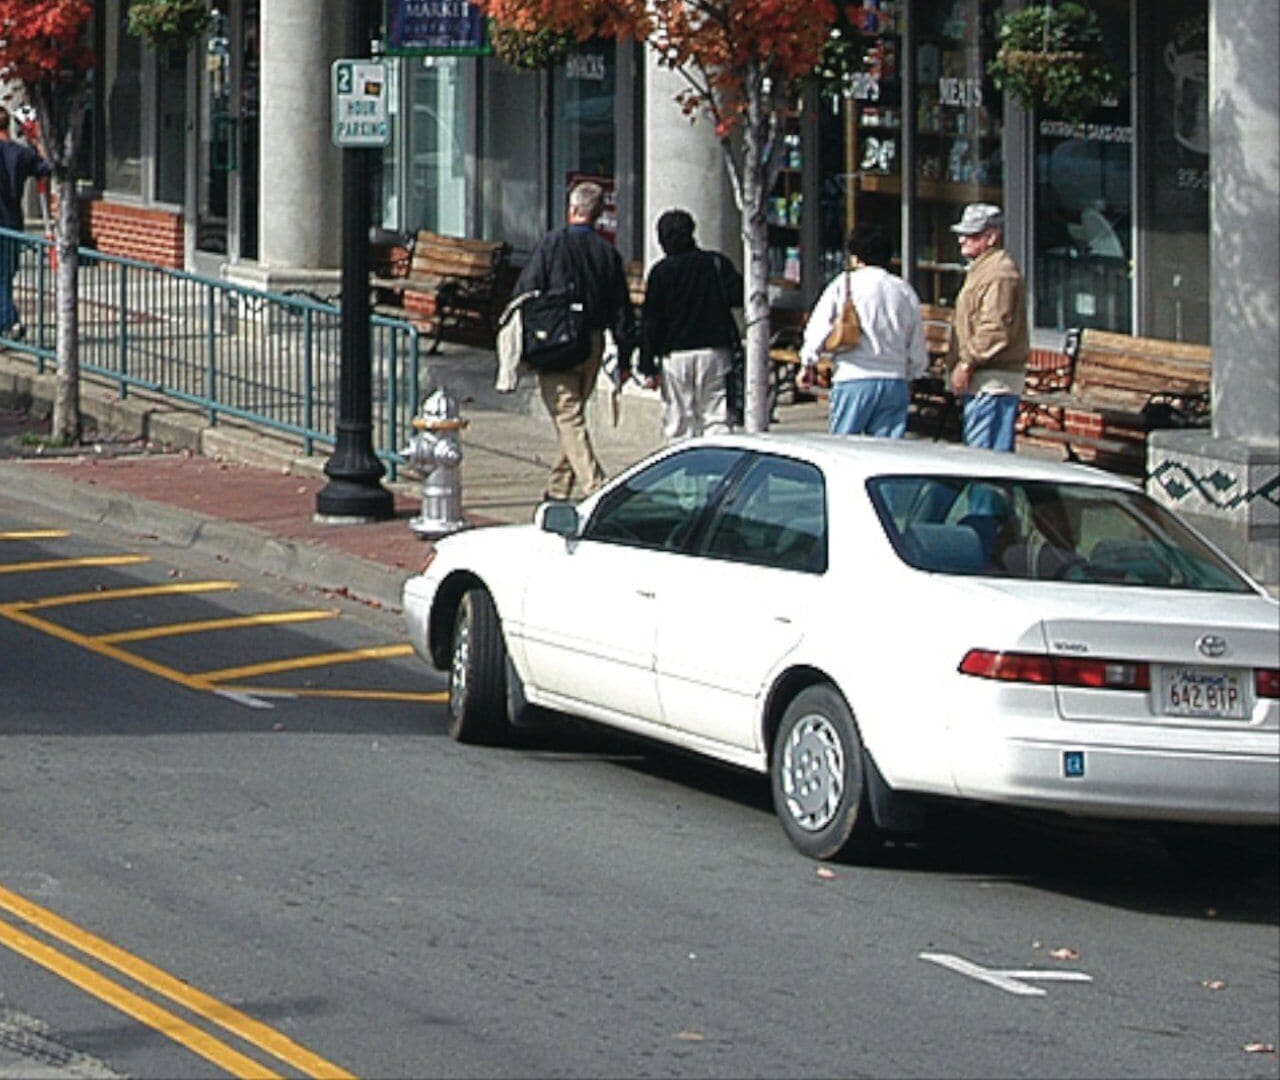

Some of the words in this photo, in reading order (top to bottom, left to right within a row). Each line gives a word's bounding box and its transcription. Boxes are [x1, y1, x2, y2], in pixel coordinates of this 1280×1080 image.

[404, 2, 470, 18] MARKET
[338, 67, 350, 91] 2
[337, 121, 388, 136] PARKING
